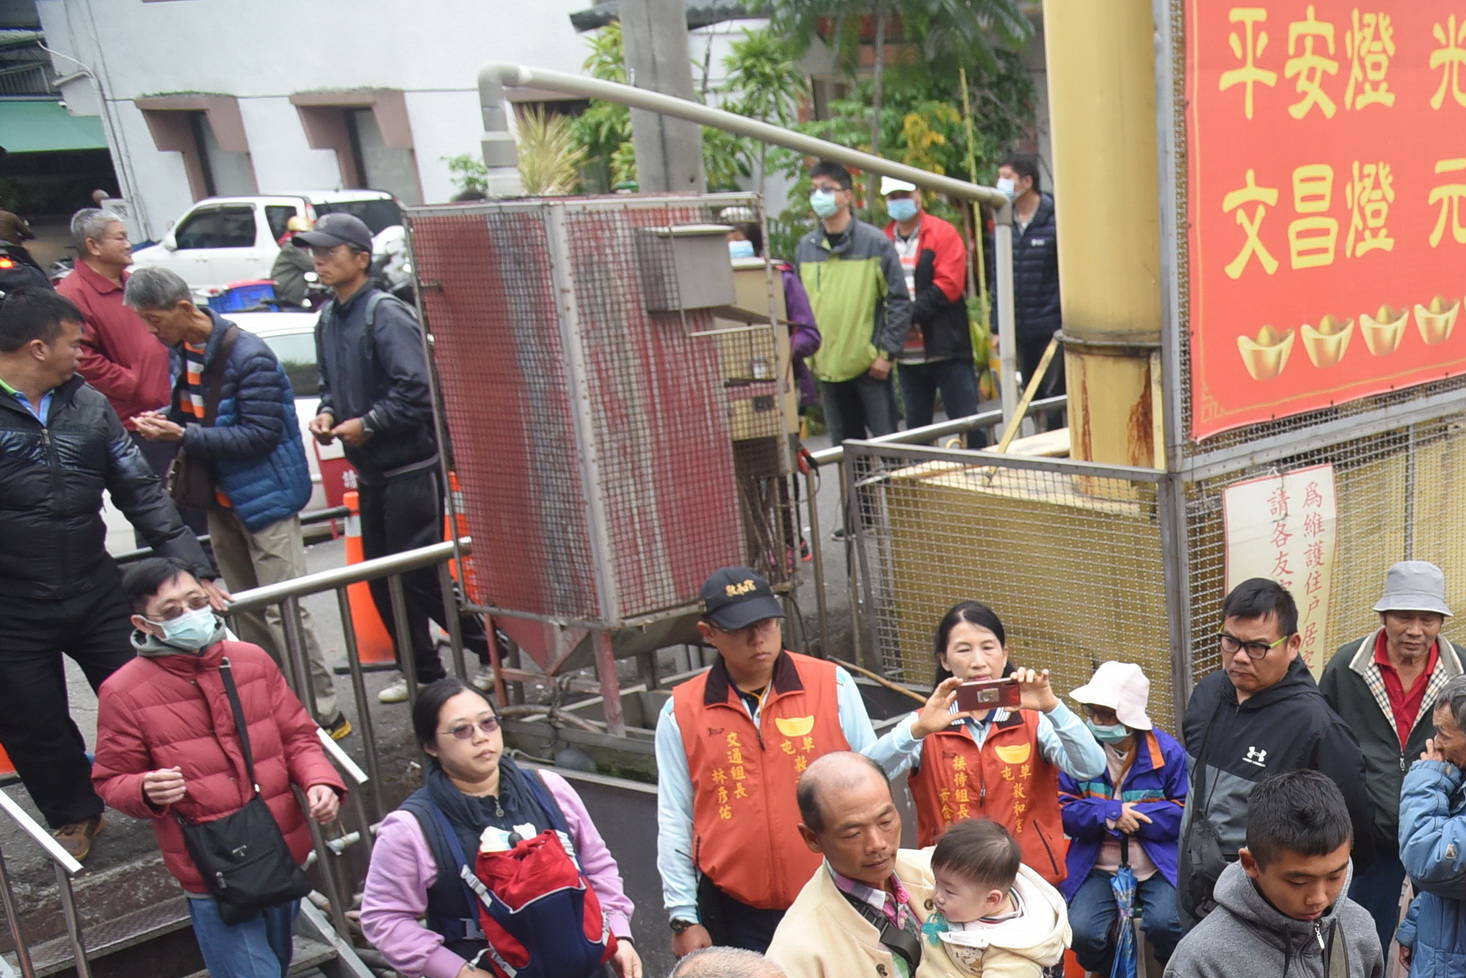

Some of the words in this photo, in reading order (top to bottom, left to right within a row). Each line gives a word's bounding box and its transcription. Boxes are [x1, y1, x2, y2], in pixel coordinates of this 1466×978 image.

[1218, 4, 1396, 120] 平安燈
[1222, 160, 1396, 280] 文昌燈
[726, 731, 748, 799] 交通組長
[953, 755, 970, 819] 接待組長
